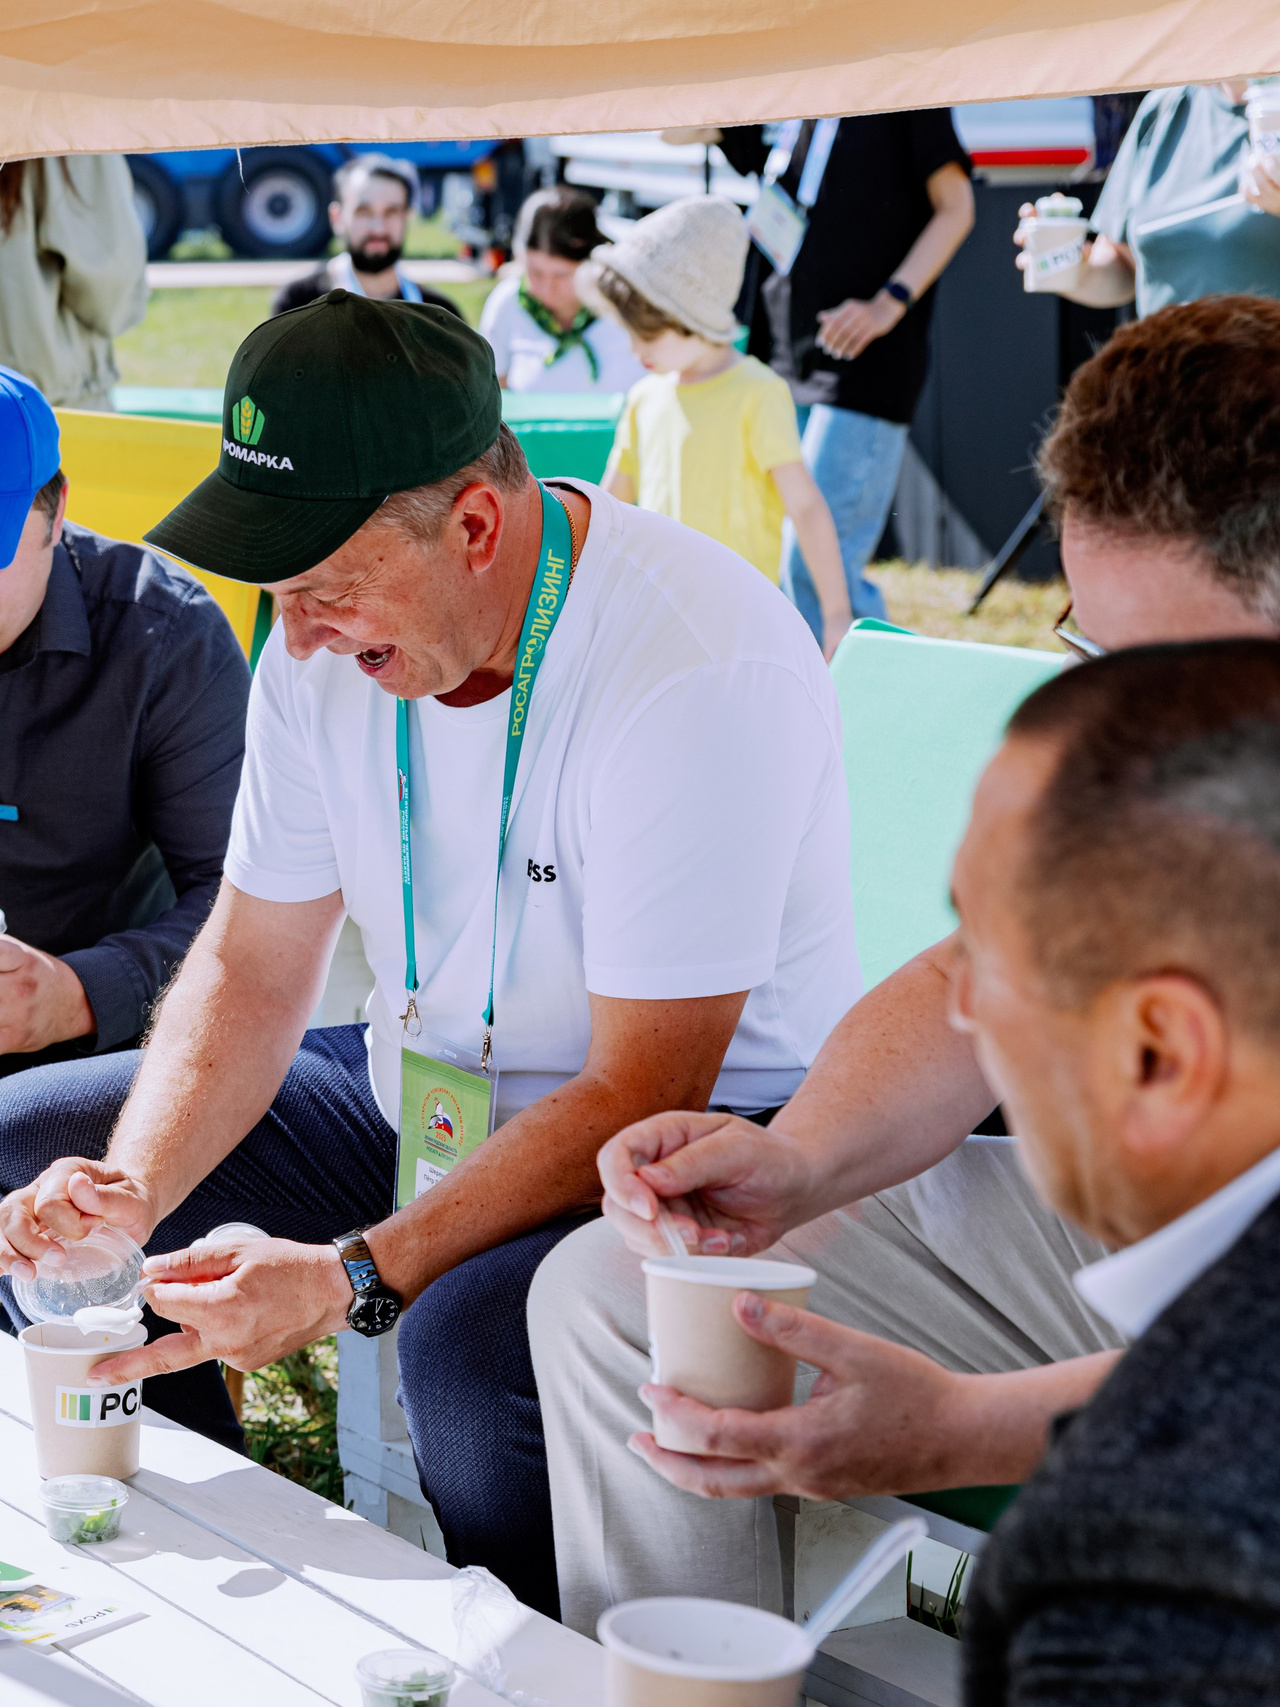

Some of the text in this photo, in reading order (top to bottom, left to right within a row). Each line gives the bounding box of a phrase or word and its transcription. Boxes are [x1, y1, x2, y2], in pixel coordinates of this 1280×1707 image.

[223, 438, 294, 471] РОМАРКА
[511, 548, 566, 737] РОСАГРОЛИЗИНГ
[100, 1383, 142, 1421] РС
